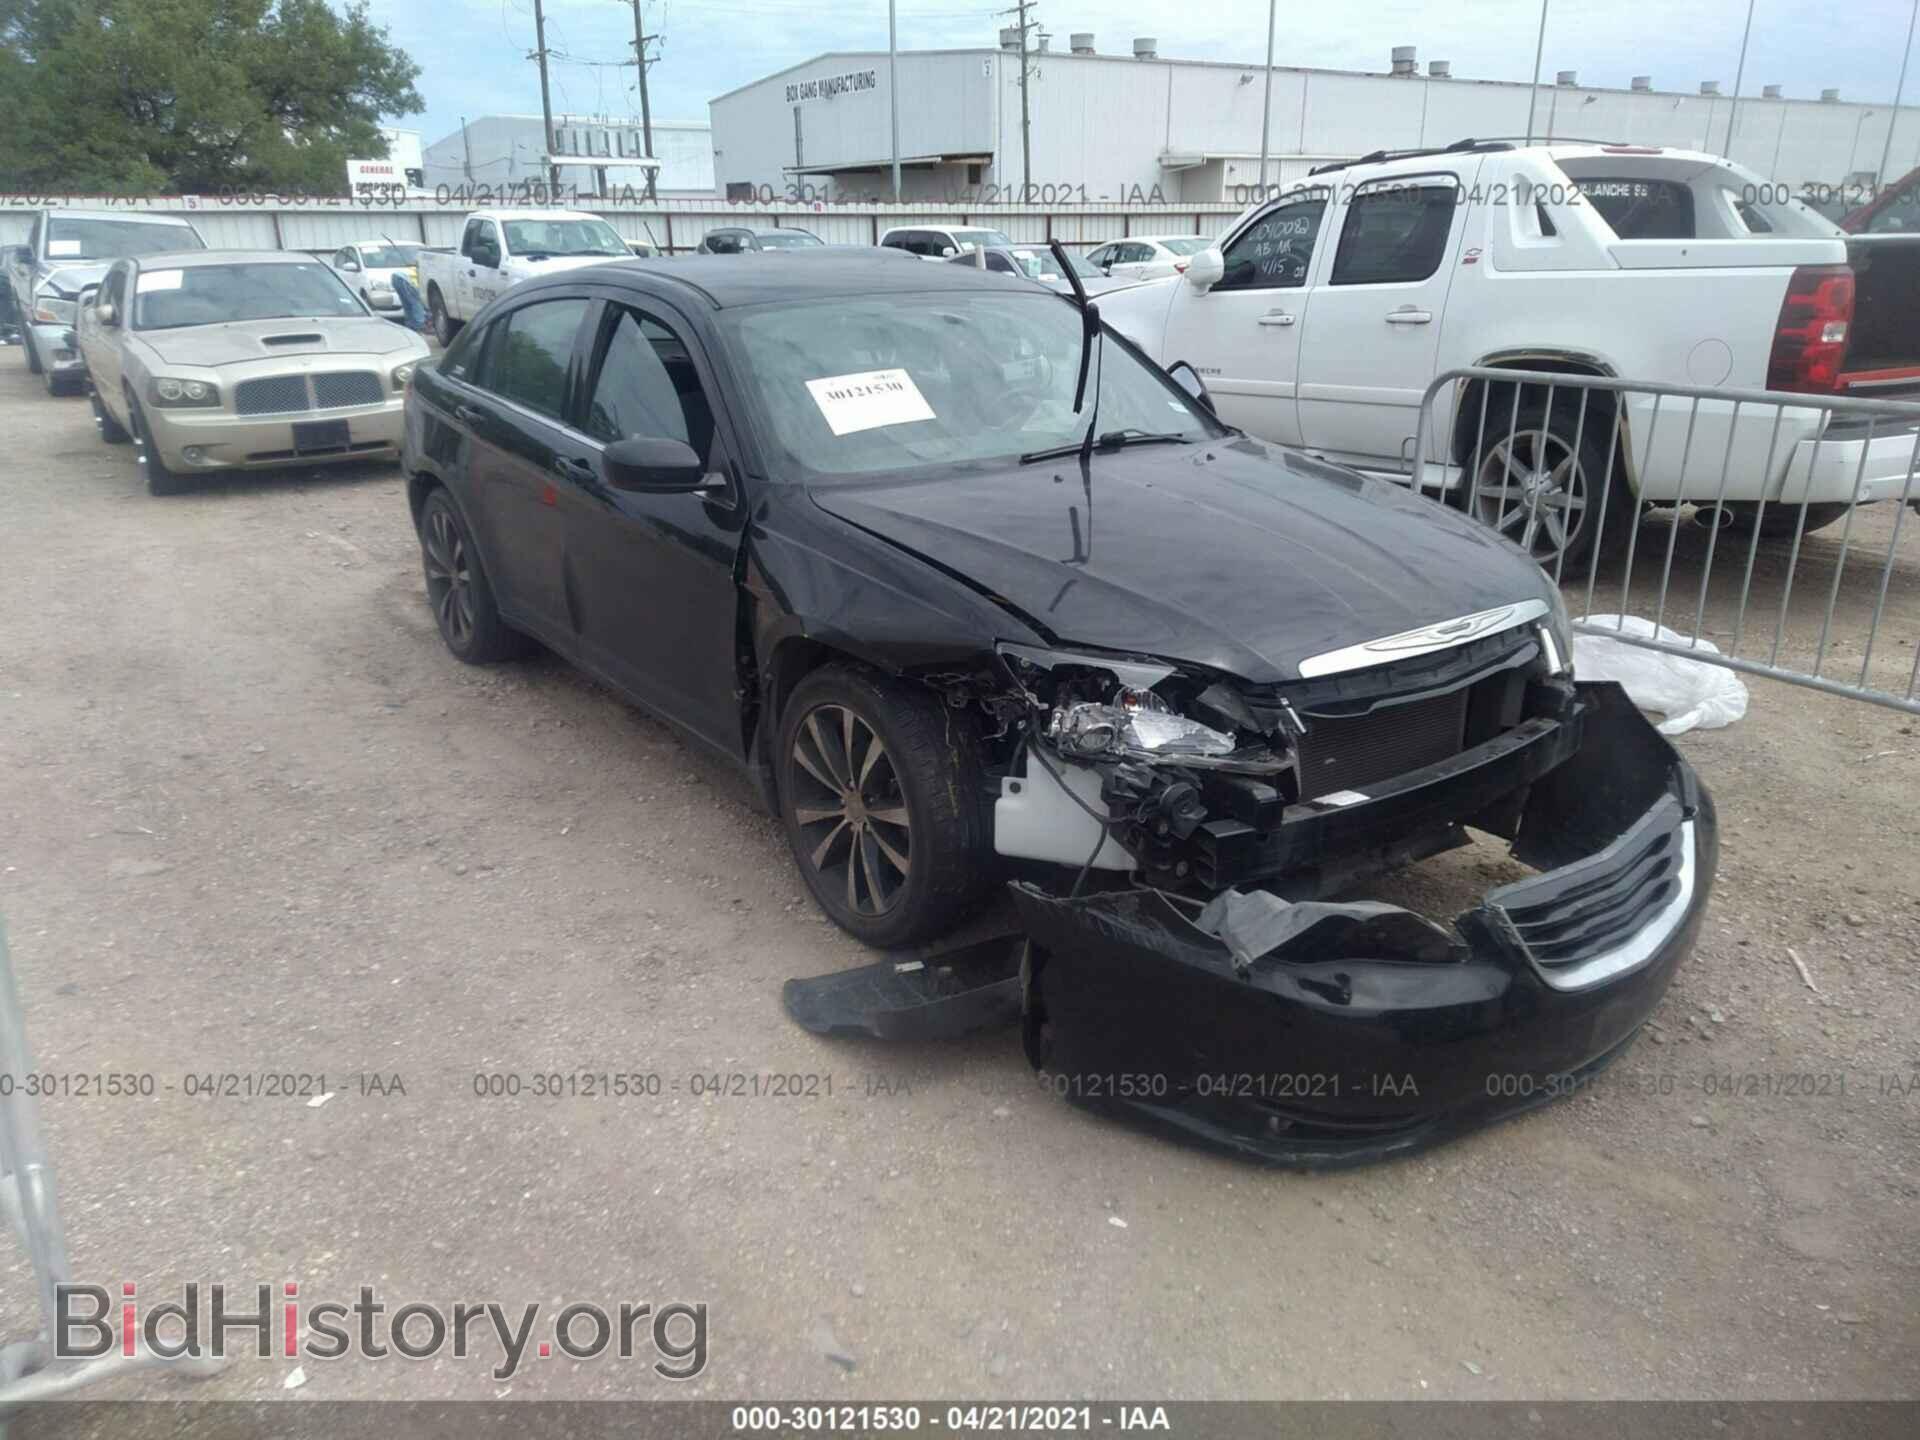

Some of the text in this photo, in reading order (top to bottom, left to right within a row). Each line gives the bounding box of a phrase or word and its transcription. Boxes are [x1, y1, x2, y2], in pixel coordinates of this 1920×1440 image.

[786, 70, 876, 102] BOX GANG MANUFACTURING
[360, 165, 393, 175] GENERAL
[825, 382, 904, 400] 30121530
